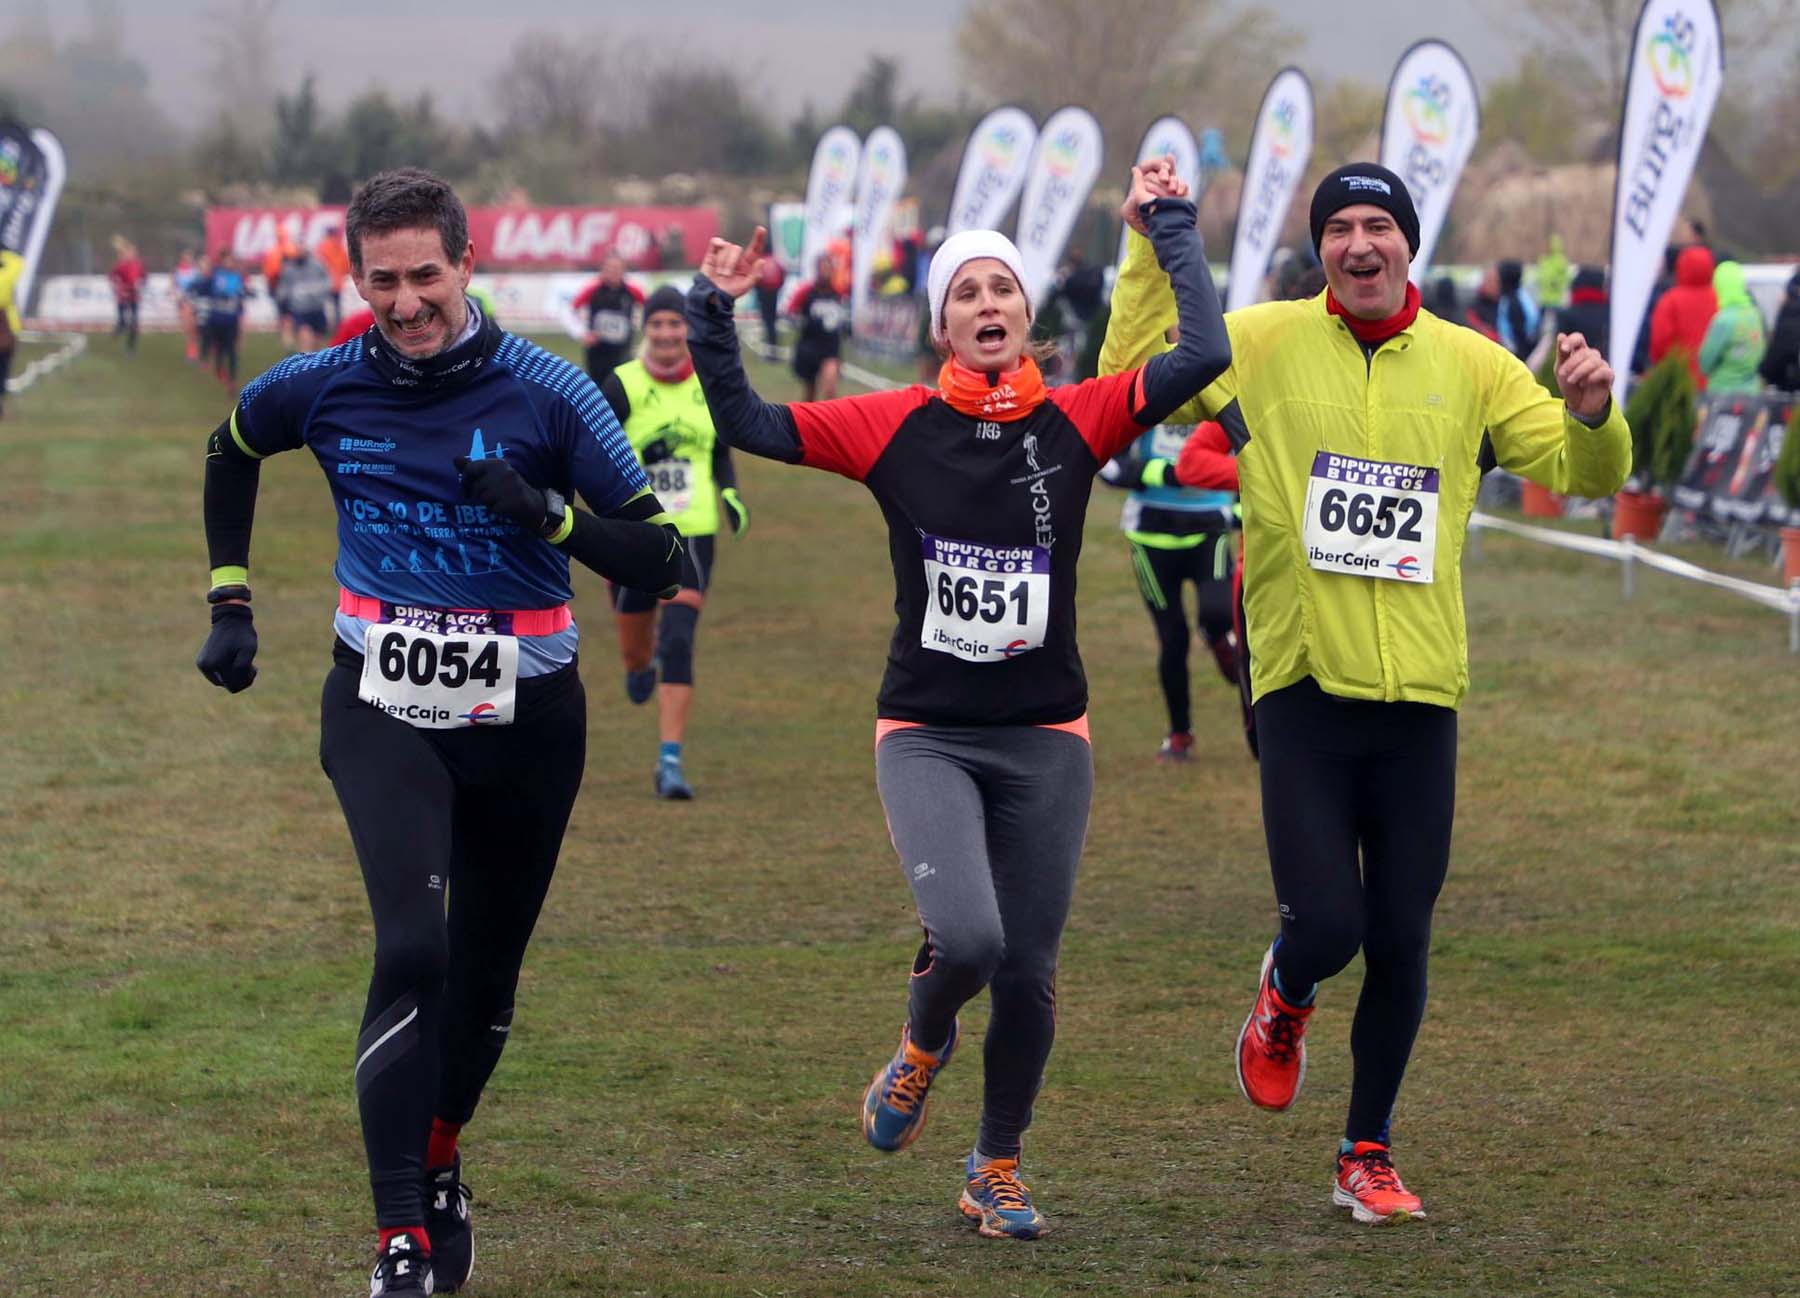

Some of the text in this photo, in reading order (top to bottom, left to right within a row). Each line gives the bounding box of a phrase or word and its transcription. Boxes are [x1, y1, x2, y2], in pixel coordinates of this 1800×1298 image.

[493, 212, 616, 260] IAAF
[1327, 467, 1423, 491] BURGOS
[1328, 455, 1427, 479] DIPUTACIÓN
[417, 501, 447, 523] DE
[1320, 488, 1423, 542] 6652
[935, 539, 1033, 561] DIPUTACIÓN
[935, 551, 1033, 573] BURGOS
[1309, 546, 1380, 570] iberCaja
[937, 571, 1029, 626] 6651
[395, 606, 494, 626] DIPUTACIÓ
[933, 628, 989, 657] iberCaja
[379, 631, 501, 689] 6054
[370, 695, 450, 724] iberCaja
